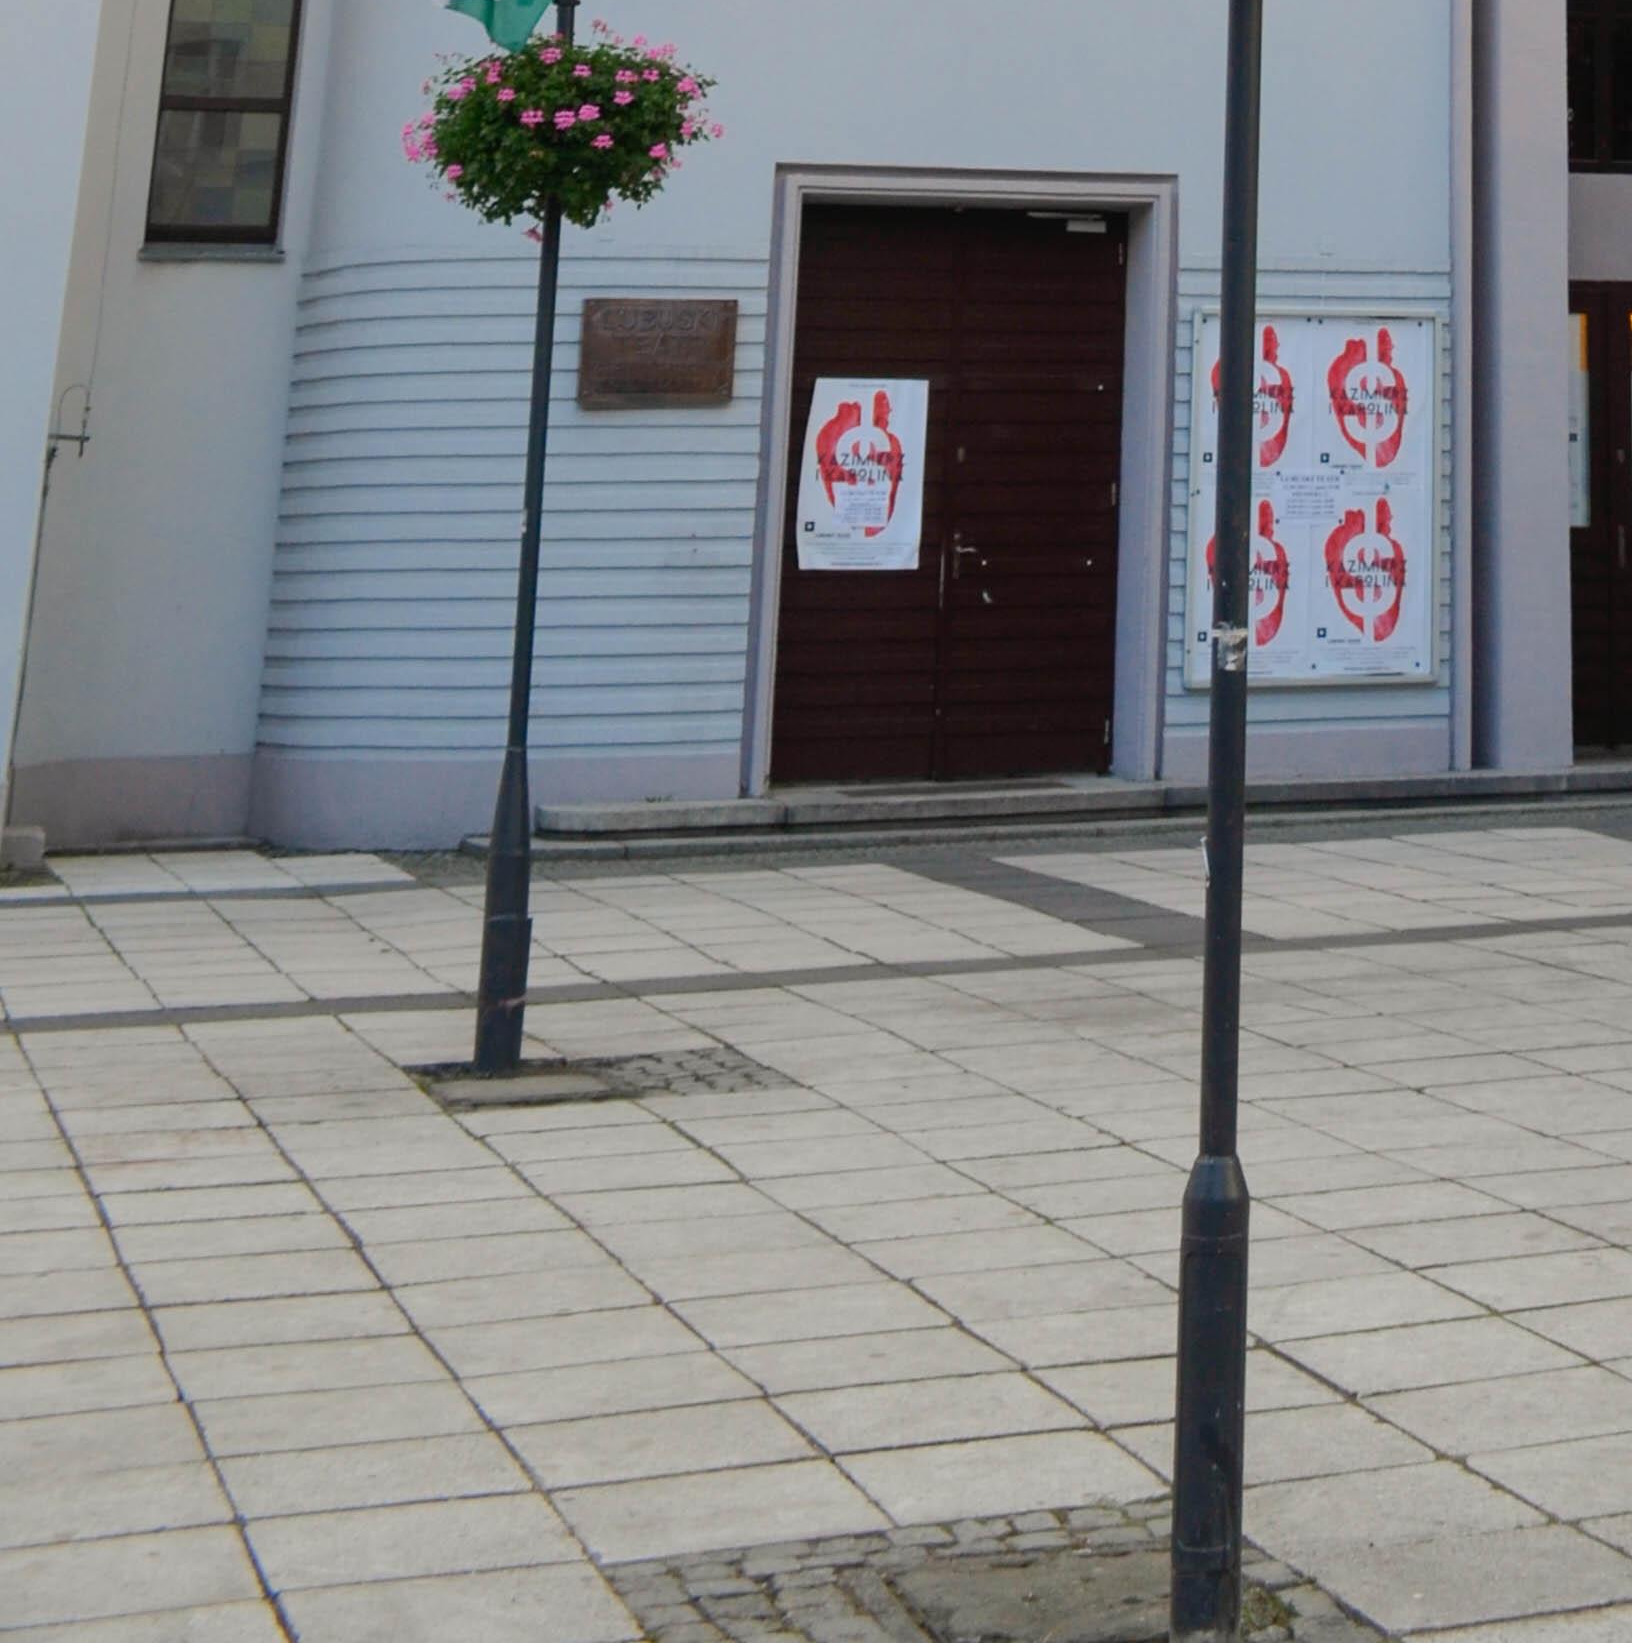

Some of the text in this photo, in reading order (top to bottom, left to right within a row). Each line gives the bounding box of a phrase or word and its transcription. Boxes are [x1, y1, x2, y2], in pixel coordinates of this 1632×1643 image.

[1329, 387, 1408, 402] KAZIMIERZ
[1336, 403, 1408, 416] KAROLINA
[817, 453, 906, 466] KAZIMIERZ
[824, 468, 904, 483] KAROLINA
[1326, 559, 1407, 573] KAZIMIERZ
[1333, 575, 1407, 588] KAROLINA
